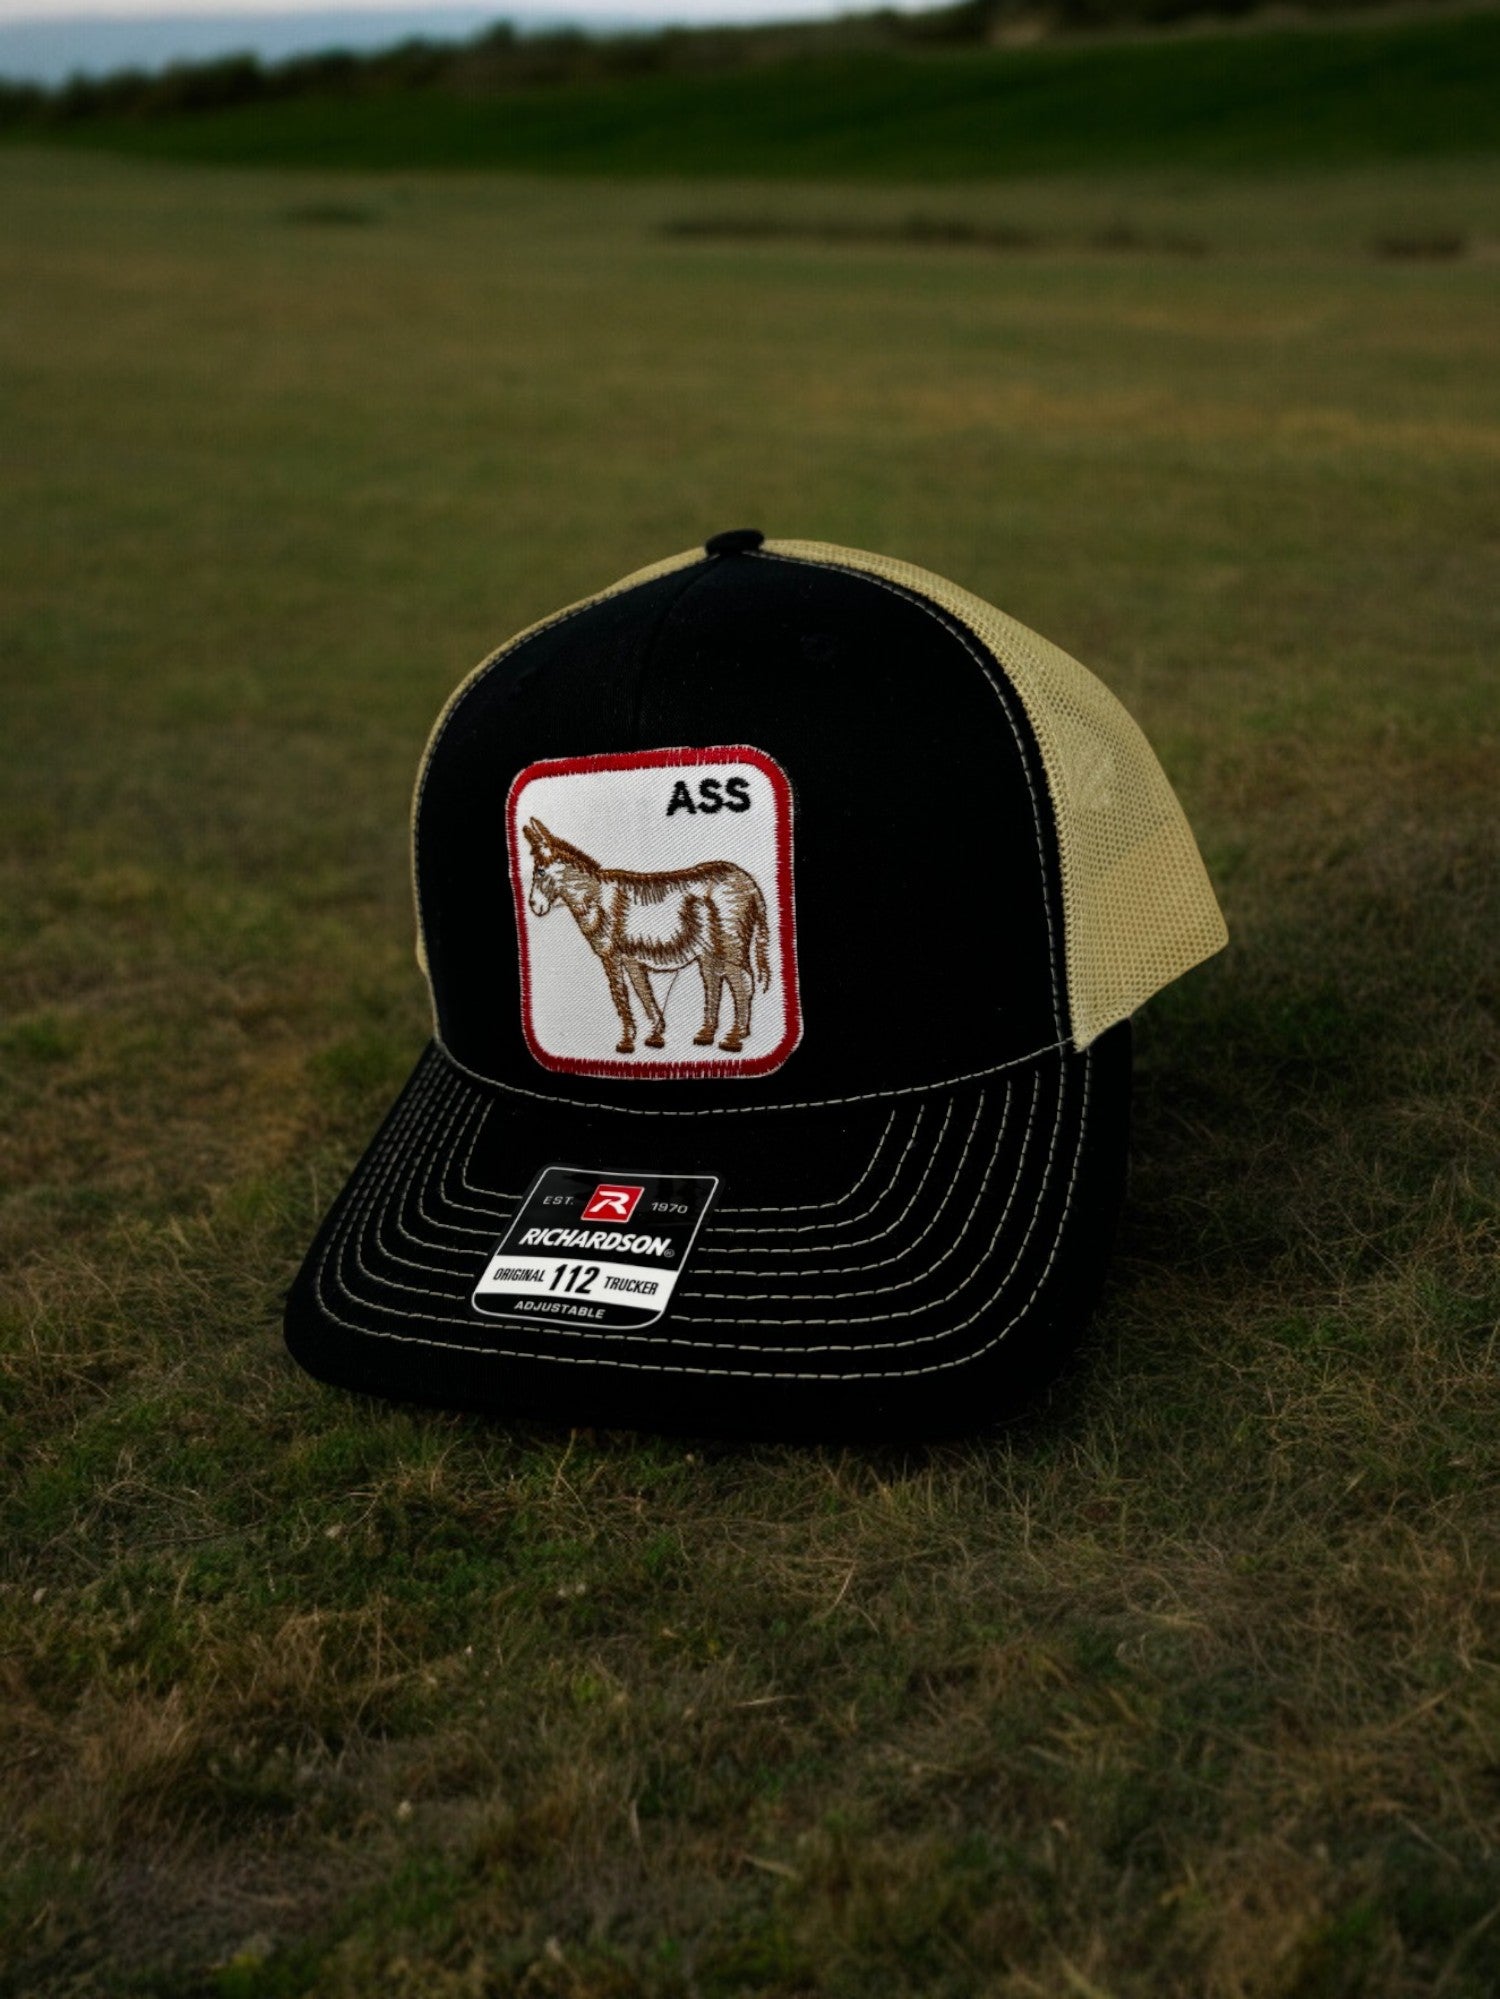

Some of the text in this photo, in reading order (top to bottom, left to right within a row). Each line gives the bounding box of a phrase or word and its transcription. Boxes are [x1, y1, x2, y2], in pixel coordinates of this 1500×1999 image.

[666, 777, 751, 816] ASS
[543, 1195, 574, 1206] EST.
[651, 1202, 688, 1214] 1970
[493, 1264, 659, 1296] ORIGINAL 112 TRUCKER
[514, 1300, 606, 1320] ADJUSTABLE
